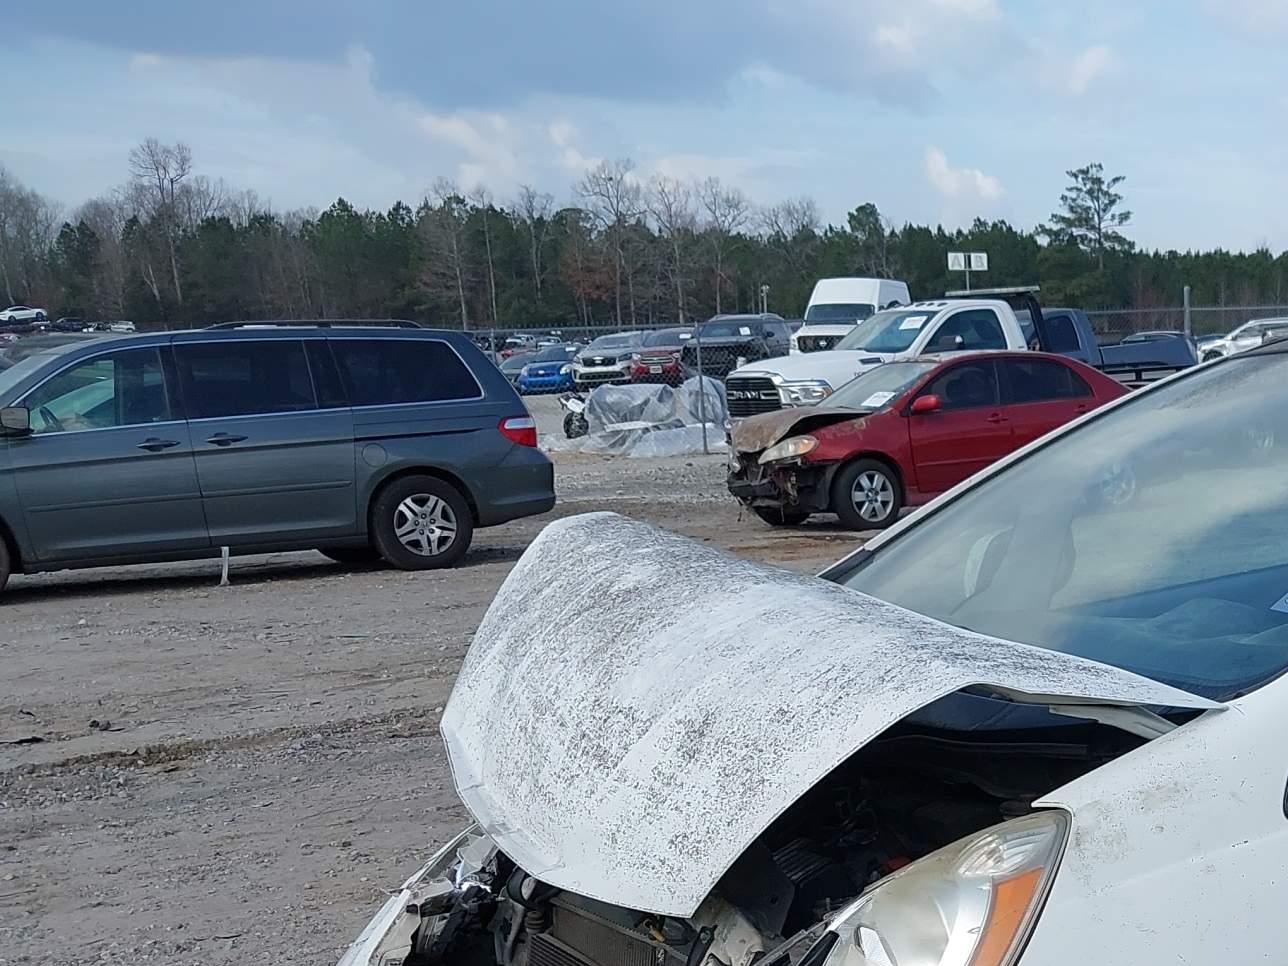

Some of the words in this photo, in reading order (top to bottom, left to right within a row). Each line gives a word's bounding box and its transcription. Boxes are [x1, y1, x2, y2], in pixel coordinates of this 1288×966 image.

[951, 254, 963, 269] A
[974, 254, 986, 269] B
[735, 390, 760, 400] RAM
